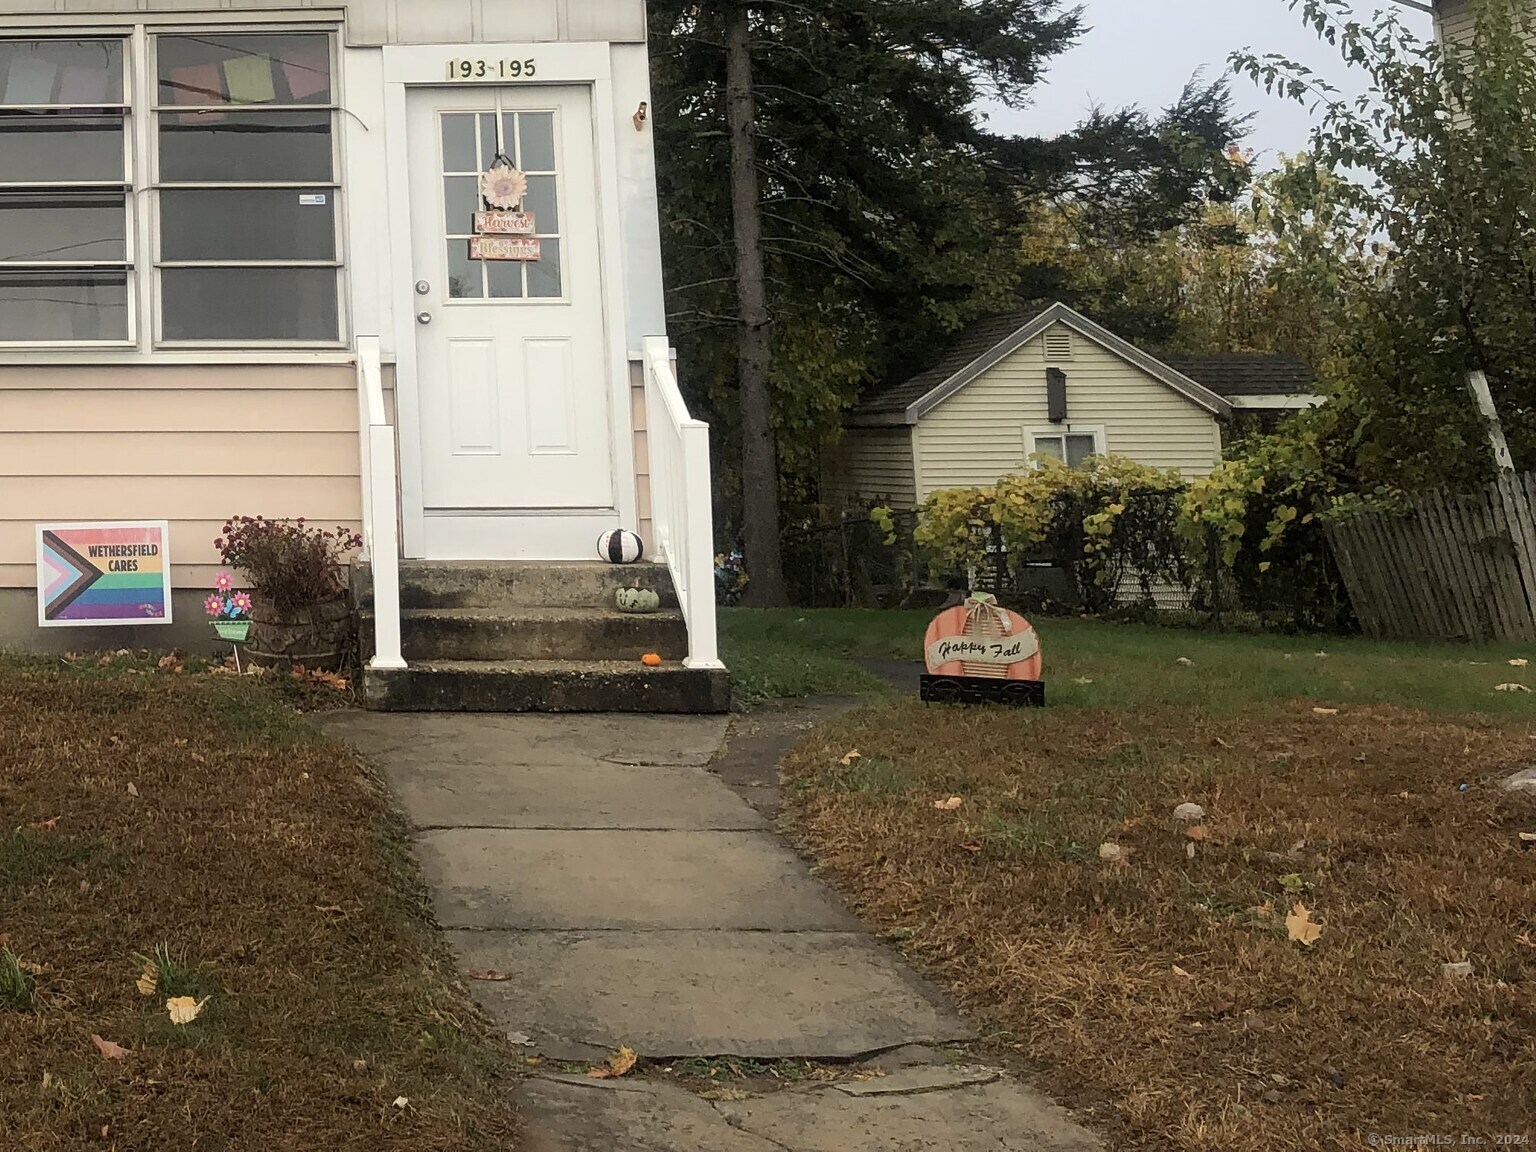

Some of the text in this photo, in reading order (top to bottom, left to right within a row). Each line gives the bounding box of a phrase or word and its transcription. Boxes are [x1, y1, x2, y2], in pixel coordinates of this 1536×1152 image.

[449, 58, 536, 78] 193-195
[482, 216, 530, 229] Harvest
[479, 241, 533, 257] Blessings
[88, 544, 159, 557] WETHERSFIELD
[108, 559, 138, 572] CARES
[938, 641, 1022, 659] Happy Fall
